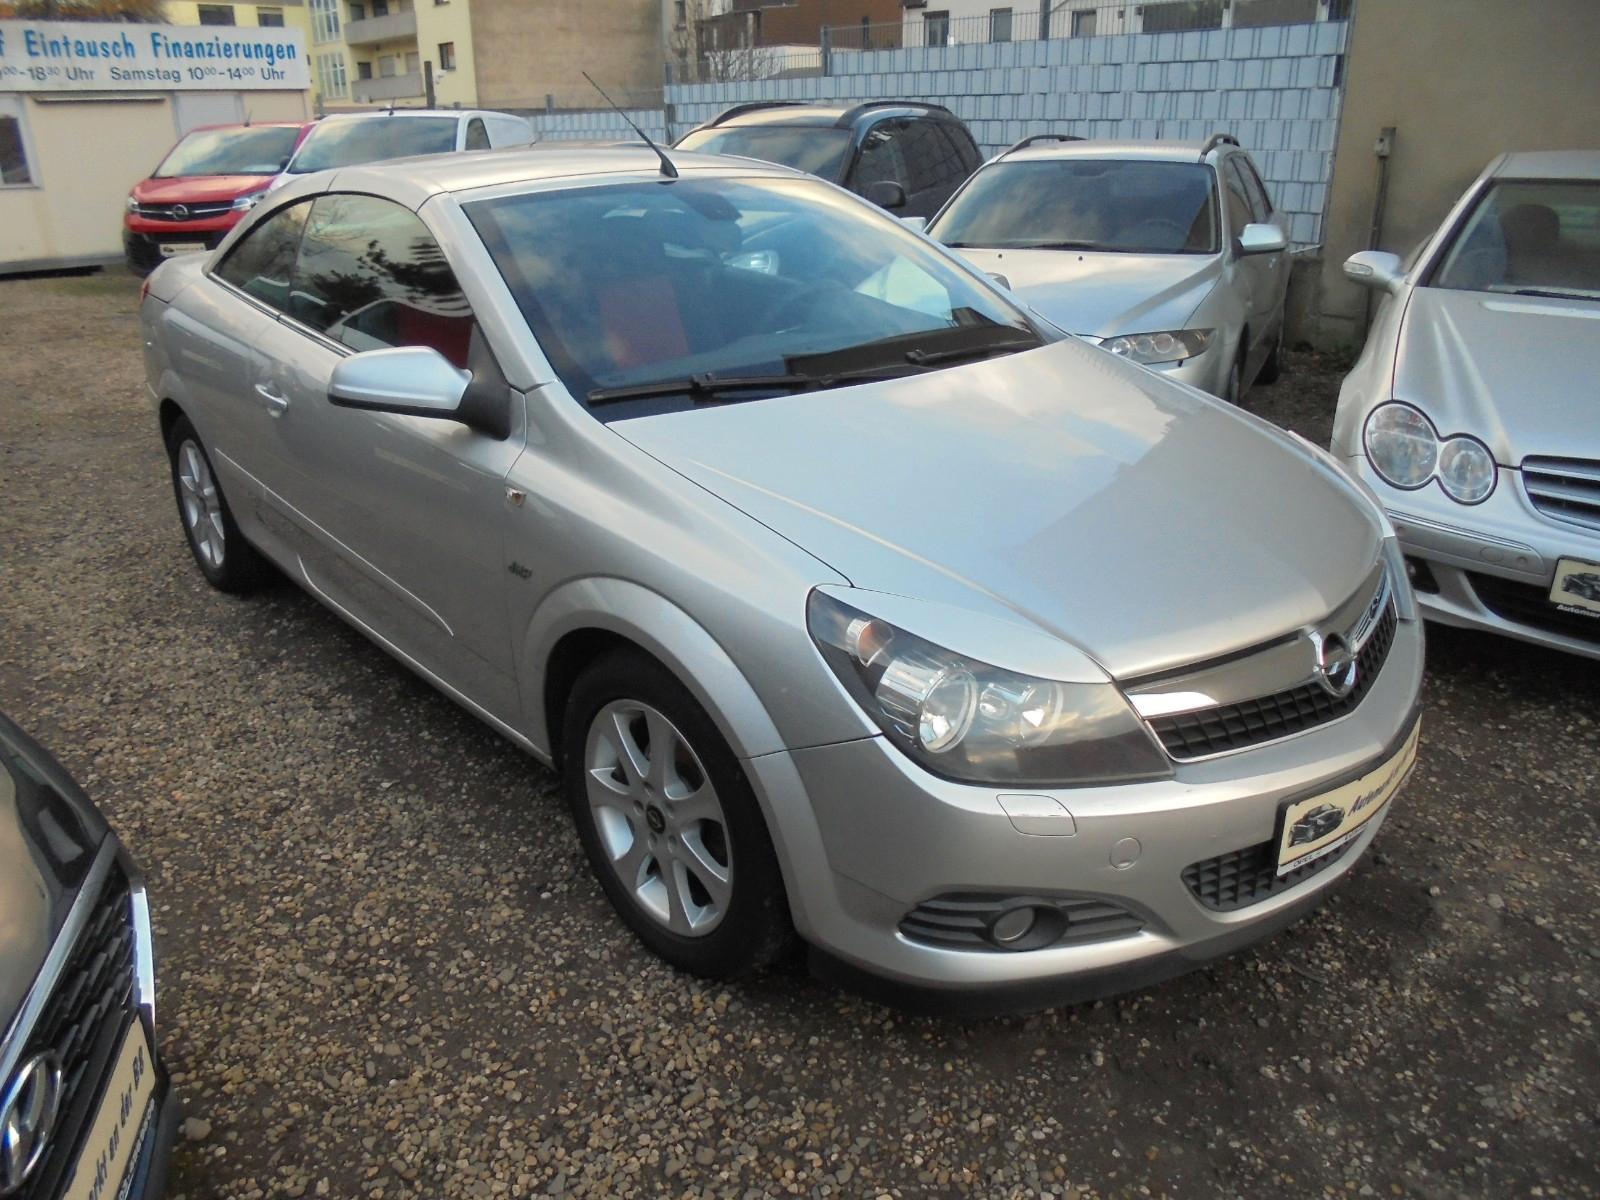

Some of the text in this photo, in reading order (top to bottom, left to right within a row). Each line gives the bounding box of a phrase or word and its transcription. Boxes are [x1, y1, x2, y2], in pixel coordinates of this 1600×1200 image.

[23, 29, 137, 58] Eintausch
[150, 32, 297, 66] Finanzierungen
[66, 66, 95, 81] Uhr
[110, 66, 182, 83] Samstag
[261, 67, 286, 80] Uhr
